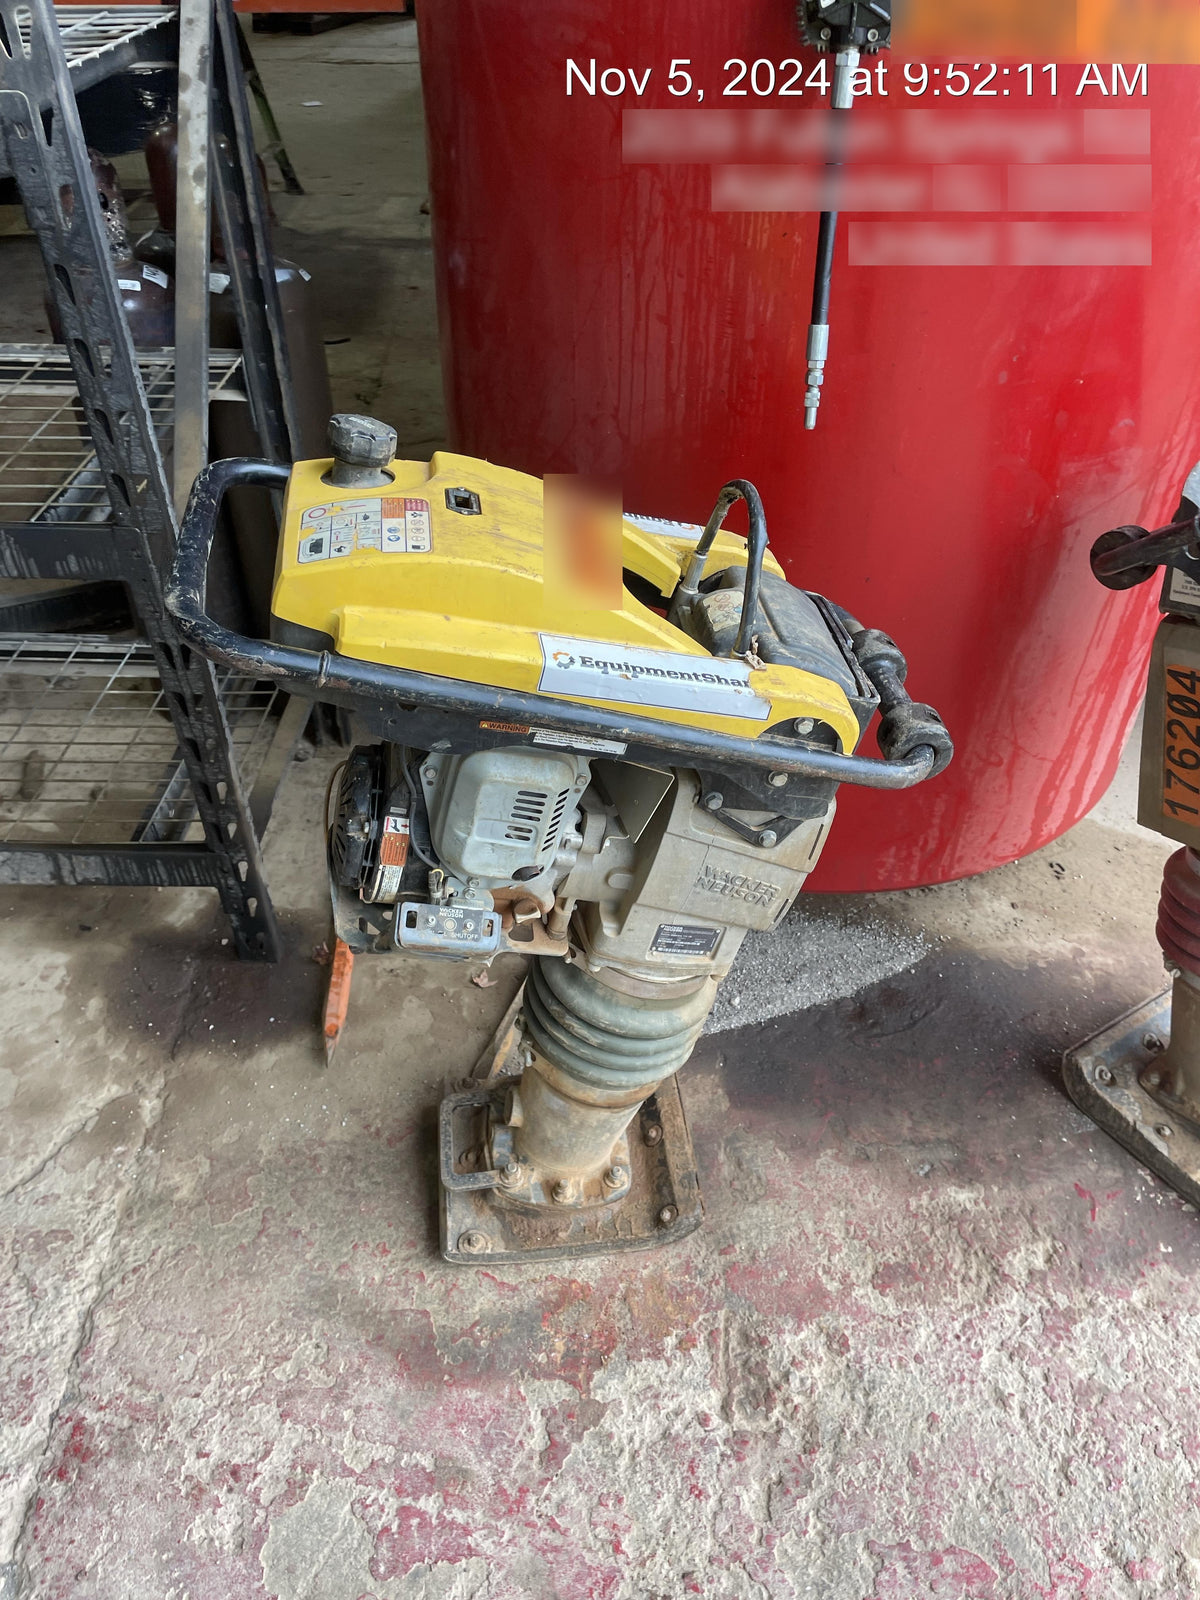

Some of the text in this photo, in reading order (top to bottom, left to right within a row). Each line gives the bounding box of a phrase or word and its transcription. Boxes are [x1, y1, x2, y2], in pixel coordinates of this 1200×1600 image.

[578, 655, 750, 689] EquipmentShar
[488, 722, 527, 733] WARNING
[1164, 668, 1200, 817] 176204
[693, 876, 773, 907] NEUSON
[704, 865, 781, 901] WACKER
[451, 931, 479, 940] SHUTOFF
